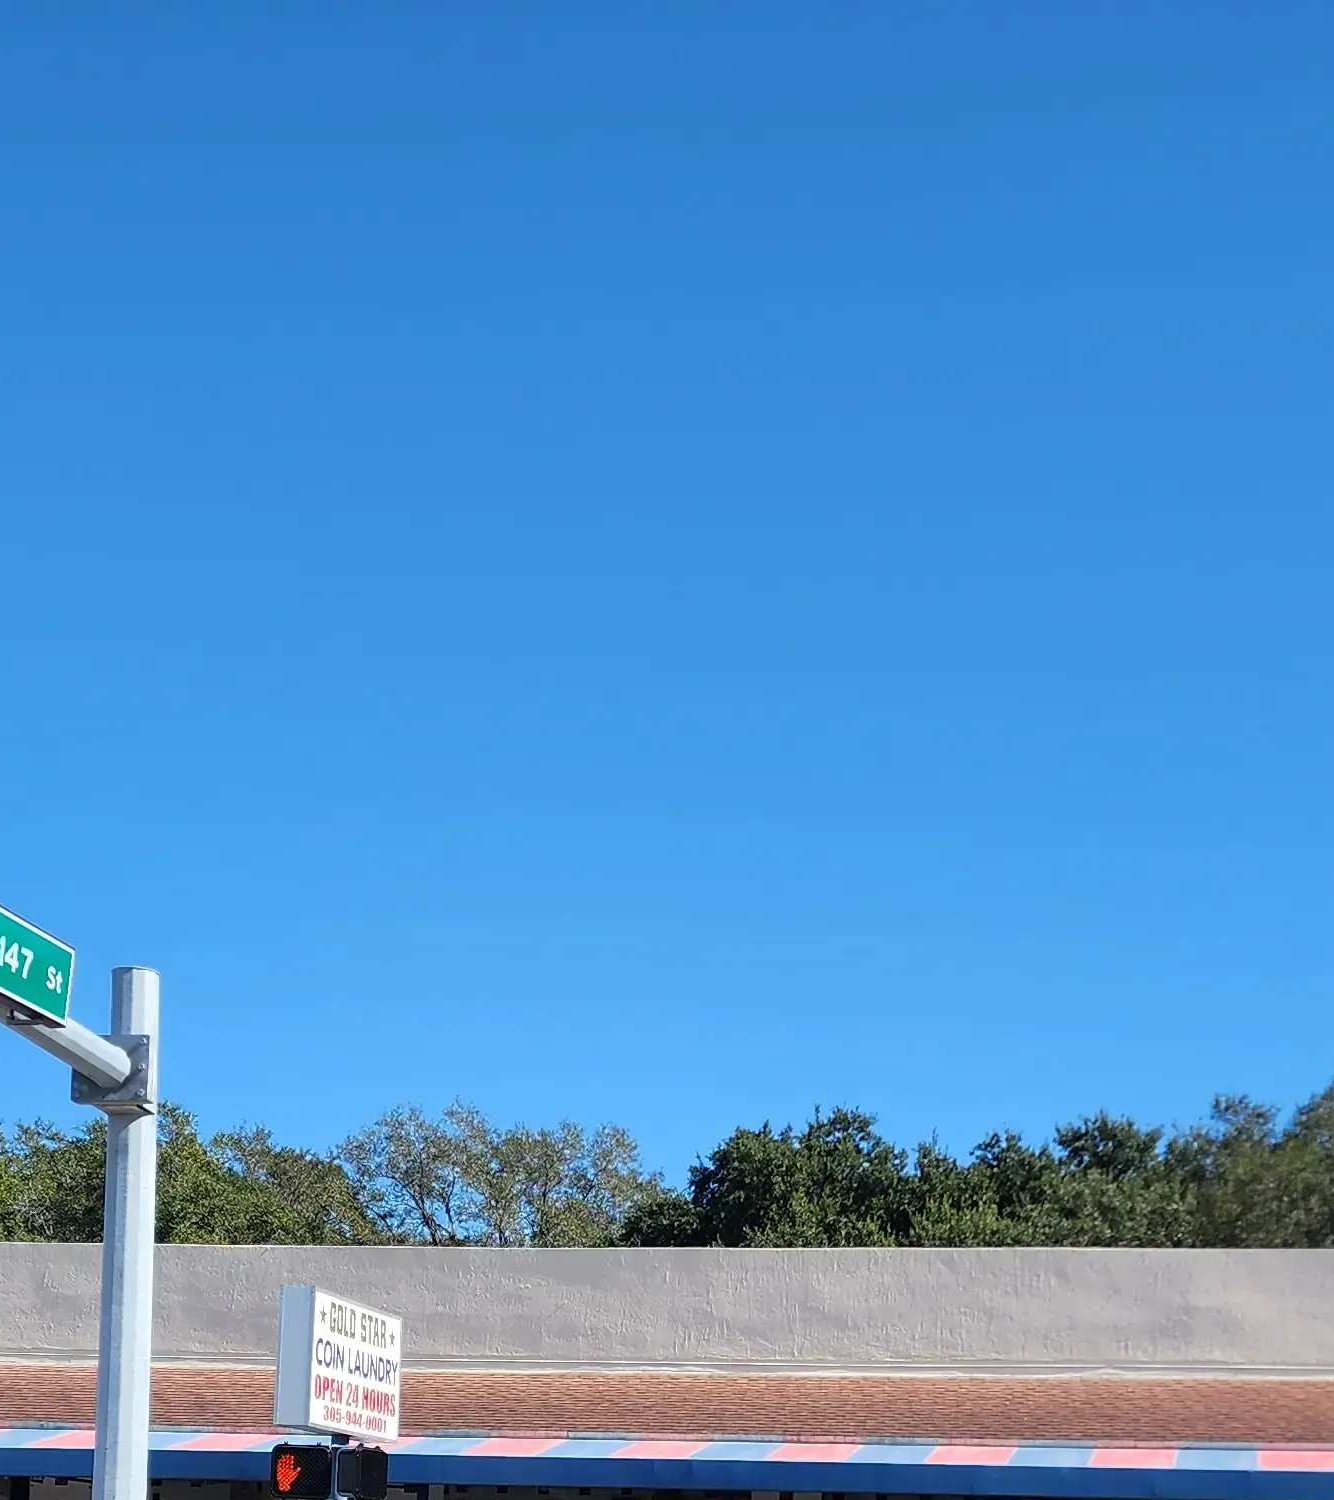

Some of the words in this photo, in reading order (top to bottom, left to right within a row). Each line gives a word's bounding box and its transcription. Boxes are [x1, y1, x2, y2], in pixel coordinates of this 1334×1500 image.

[46, 965, 63, 994] St
[329, 1301, 357, 1340] GOLD
[360, 1312, 387, 1349] STAR
[315, 1337, 345, 1373] COIN
[348, 1347, 398, 1386] LAUNDRY
[314, 1373, 344, 1405] OPEN
[345, 1381, 360, 1408] 24
[361, 1386, 396, 1417] HOURS
[323, 1404, 387, 1433] 305-944-0001
